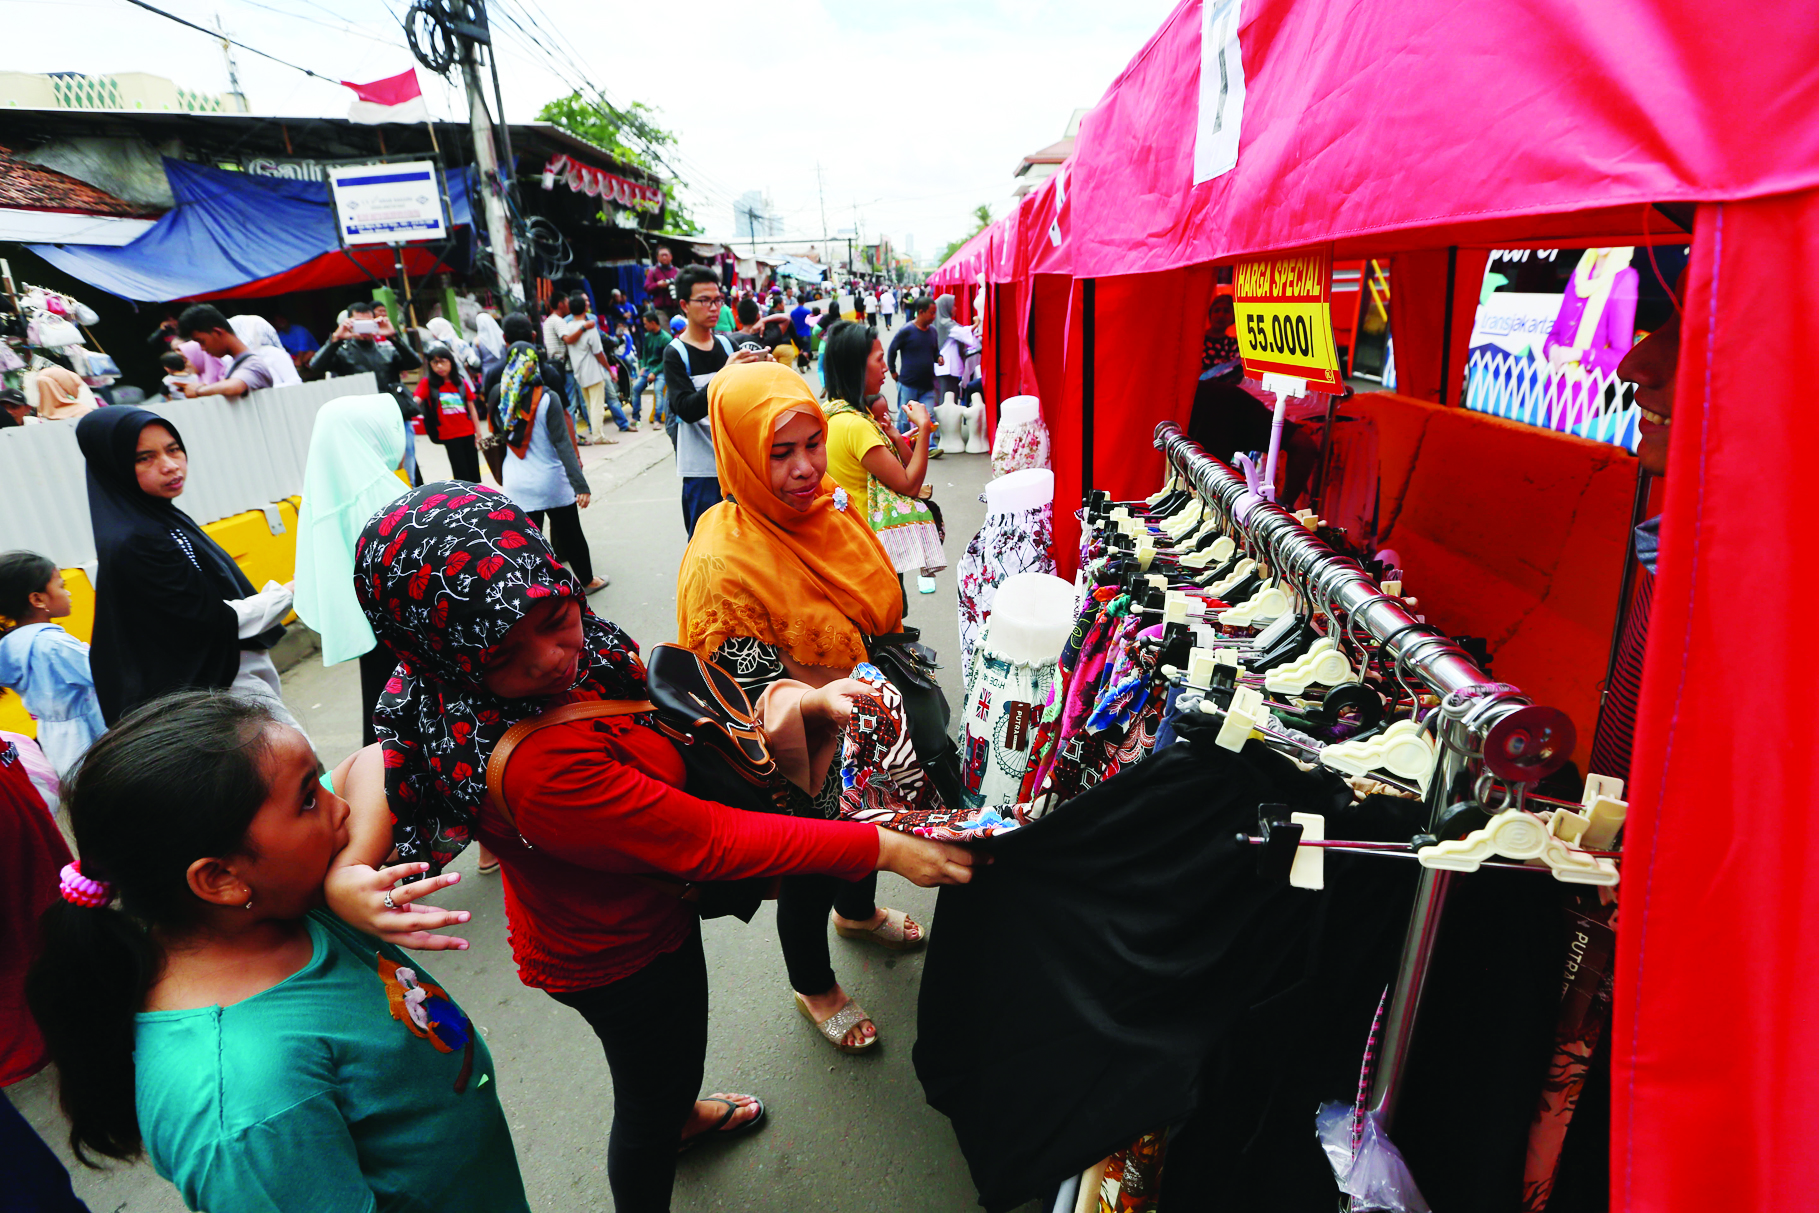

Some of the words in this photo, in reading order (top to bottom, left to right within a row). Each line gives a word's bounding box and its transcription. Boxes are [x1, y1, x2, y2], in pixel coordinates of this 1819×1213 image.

[1238, 261, 1271, 297] HARGA
[1273, 255, 1320, 297] SPECIAL
[1481, 313, 1555, 336] transjakarta
[1013, 710, 1023, 735] PUTRA
[1564, 931, 1589, 980] PUTRA
